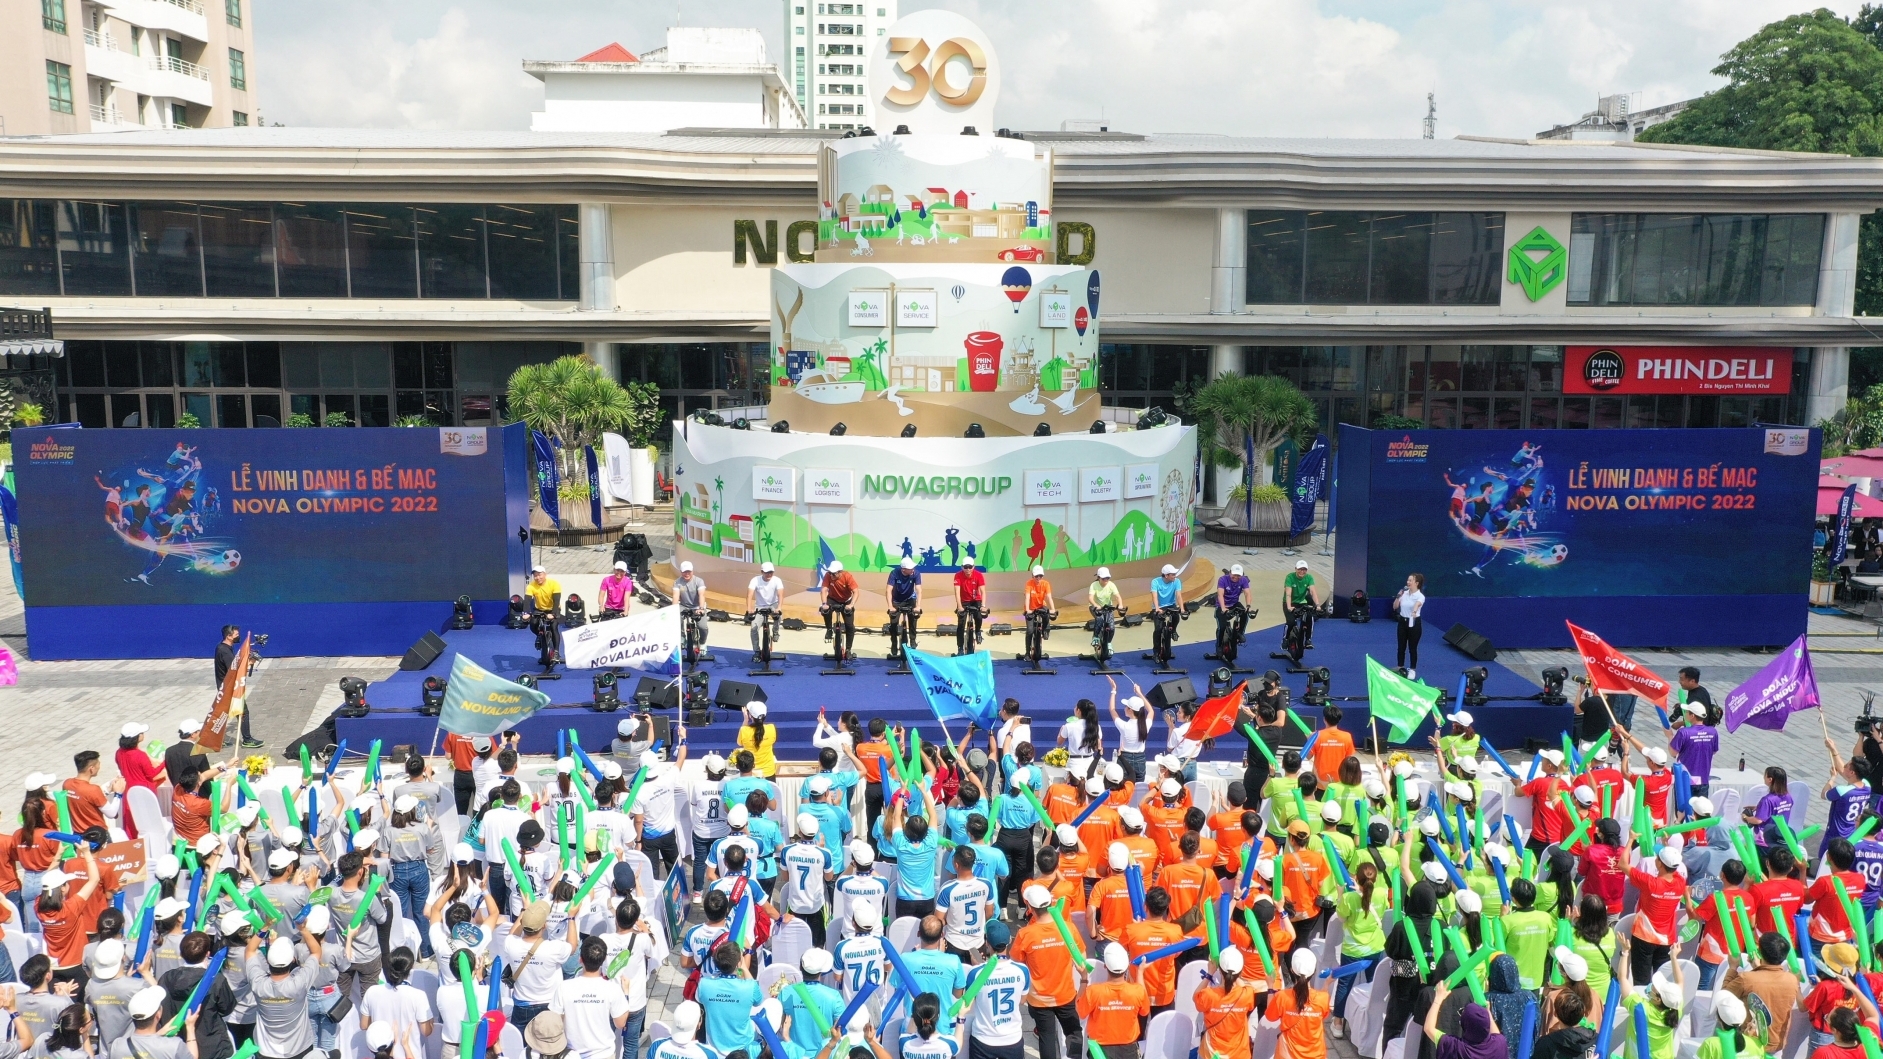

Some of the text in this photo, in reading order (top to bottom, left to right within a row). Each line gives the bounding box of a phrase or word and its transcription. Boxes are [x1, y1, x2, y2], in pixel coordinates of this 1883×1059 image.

[885, 37, 987, 106] 30
[1591, 359, 1618, 368] PHIN
[1637, 358, 1774, 380] PHINDELI
[1591, 369, 1617, 378] DELI
[444, 432, 462, 444] 30
[1769, 433, 1785, 445] 30
[231, 462, 436, 493] LỄ VINH DANH & BẾ MẠC
[864, 473, 1012, 496] NOVAGROUP
[1568, 462, 1757, 492] LỄ VINH DANH & BẾ MẠC
[1297, 476, 1308, 503] NOVA
[232, 496, 438, 514] NOVA OLYMPIC 2022
[1566, 495, 1755, 510] NOVA OLYMPIC 2022
[609, 632, 647, 649] ĐOÀN
[590, 642, 669, 668] NOVALAND 5
[1605, 656, 1637, 671] ĐOÀN
[1607, 666, 1664, 690] CONSUMER
[1762, 674, 1789, 697] ĐOÀN
[460, 700, 520, 716] NOVALAND
[975, 695, 982, 704] 6
[1387, 694, 1414, 709] NOVA
[1746, 699, 1773, 718] NOVA
[708, 798, 720, 818] 8
[788, 856, 815, 864] NOVALAND
[797, 866, 810, 891] 7
[954, 891, 982, 901] NOVALAND
[964, 901, 978, 926] 5
[844, 950, 877, 958] NOVALAND
[848, 960, 880, 992] 76
[988, 988, 1015, 1016] 13
